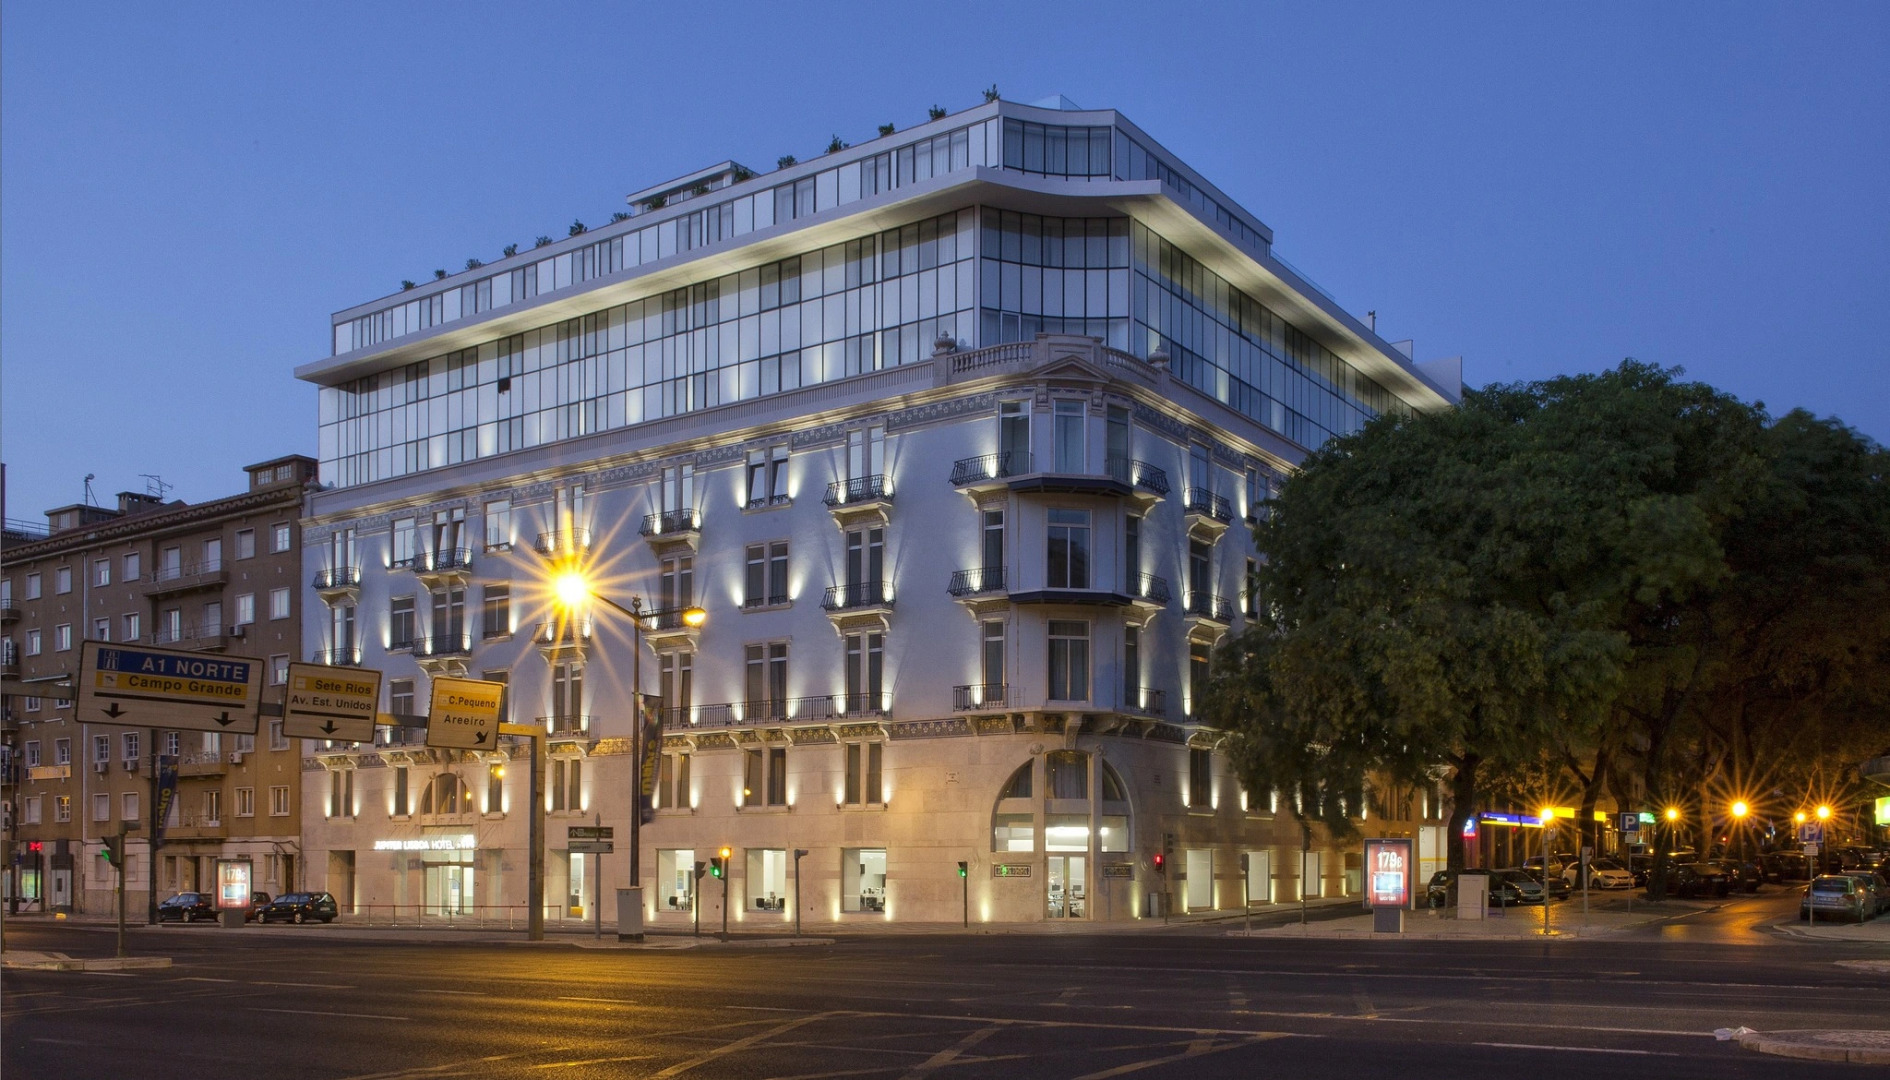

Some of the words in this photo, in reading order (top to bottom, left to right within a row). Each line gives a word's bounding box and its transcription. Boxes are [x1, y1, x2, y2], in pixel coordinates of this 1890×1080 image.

[141, 656, 166, 673] A1
[176, 660, 244, 680] NORTE
[128, 675, 183, 692] Campo
[188, 681, 242, 696] Grande
[314, 679, 342, 693] Sete
[345, 683, 372, 695] Rios
[291, 695, 309, 705] Av.
[312, 696, 332, 708] Est.
[336, 700, 372, 711] Unidos
[449, 695, 496, 709] C.Pequeno
[444, 714, 485, 727] Areeiro
[1625, 815, 1636, 829] P
[1804, 823, 1818, 840] P
[431, 840, 455, 850] HOTEL
